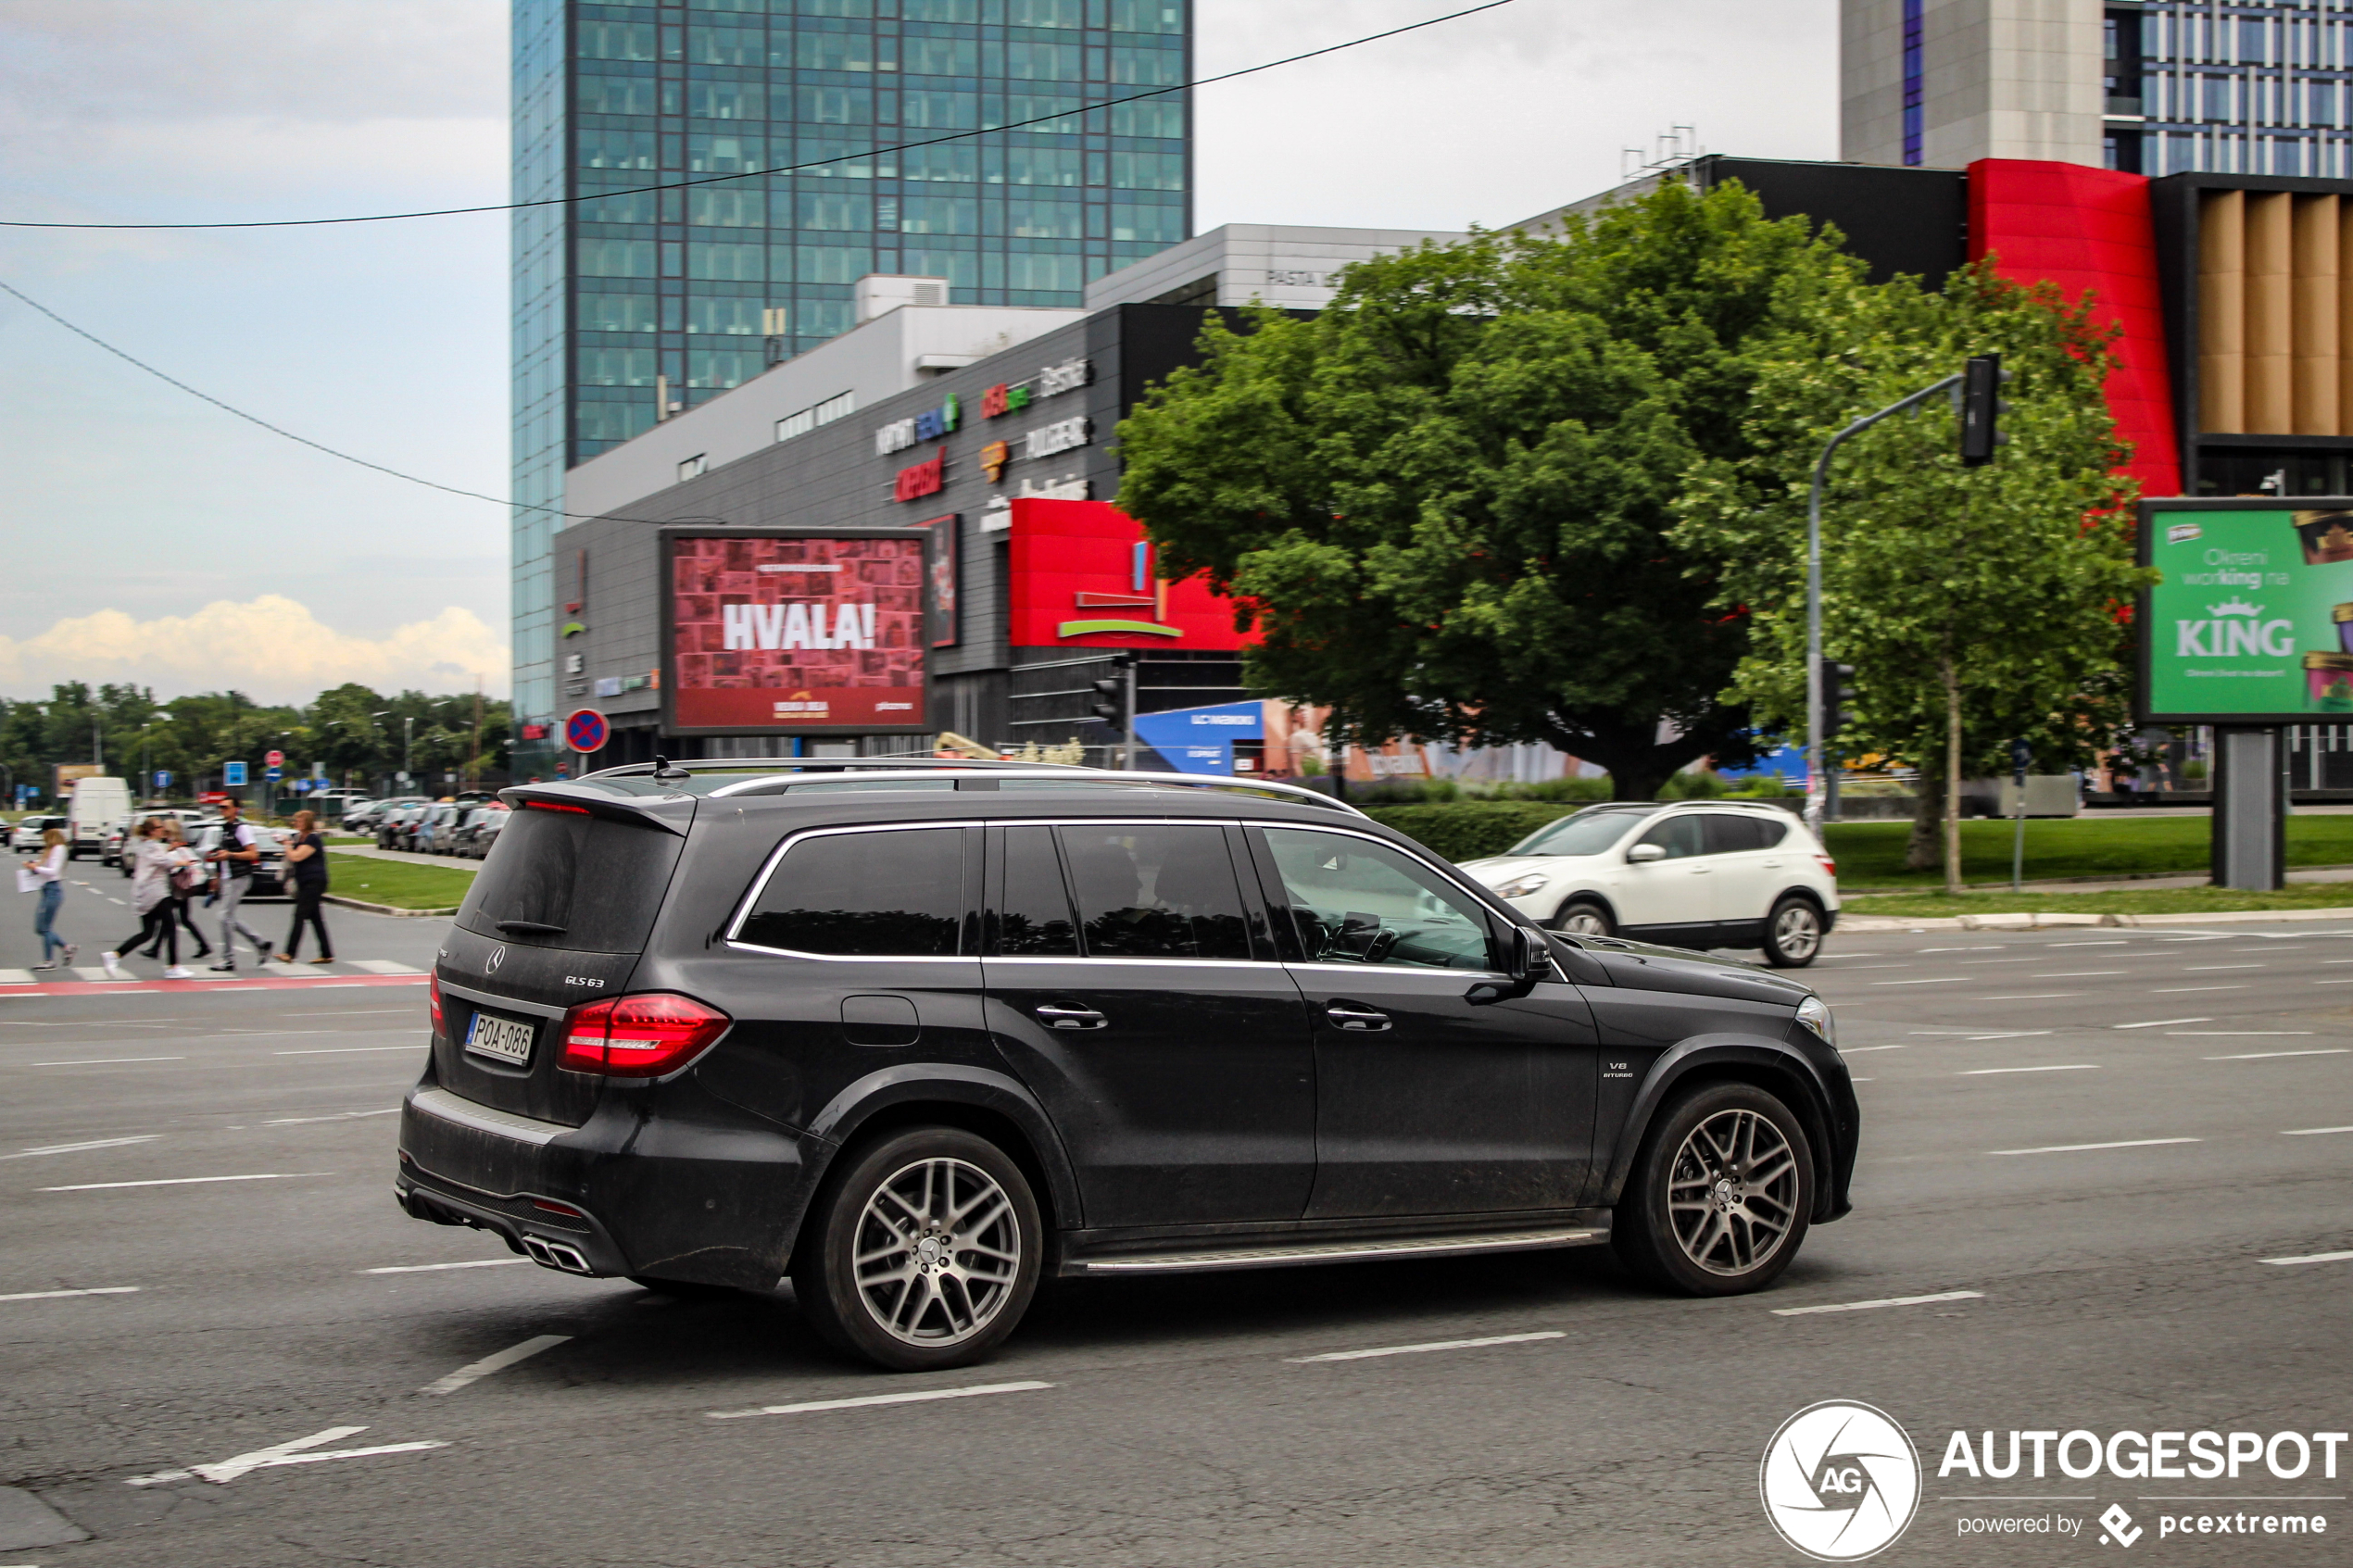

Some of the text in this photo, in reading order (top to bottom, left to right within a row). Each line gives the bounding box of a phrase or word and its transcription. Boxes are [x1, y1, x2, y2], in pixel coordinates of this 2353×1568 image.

[2182, 568, 2262, 590] working
[723, 603, 875, 650] HVALA!
[2175, 619, 2296, 658] KING
[565, 975, 605, 988] GLS 63
[473, 1018, 530, 1055] POA-086
